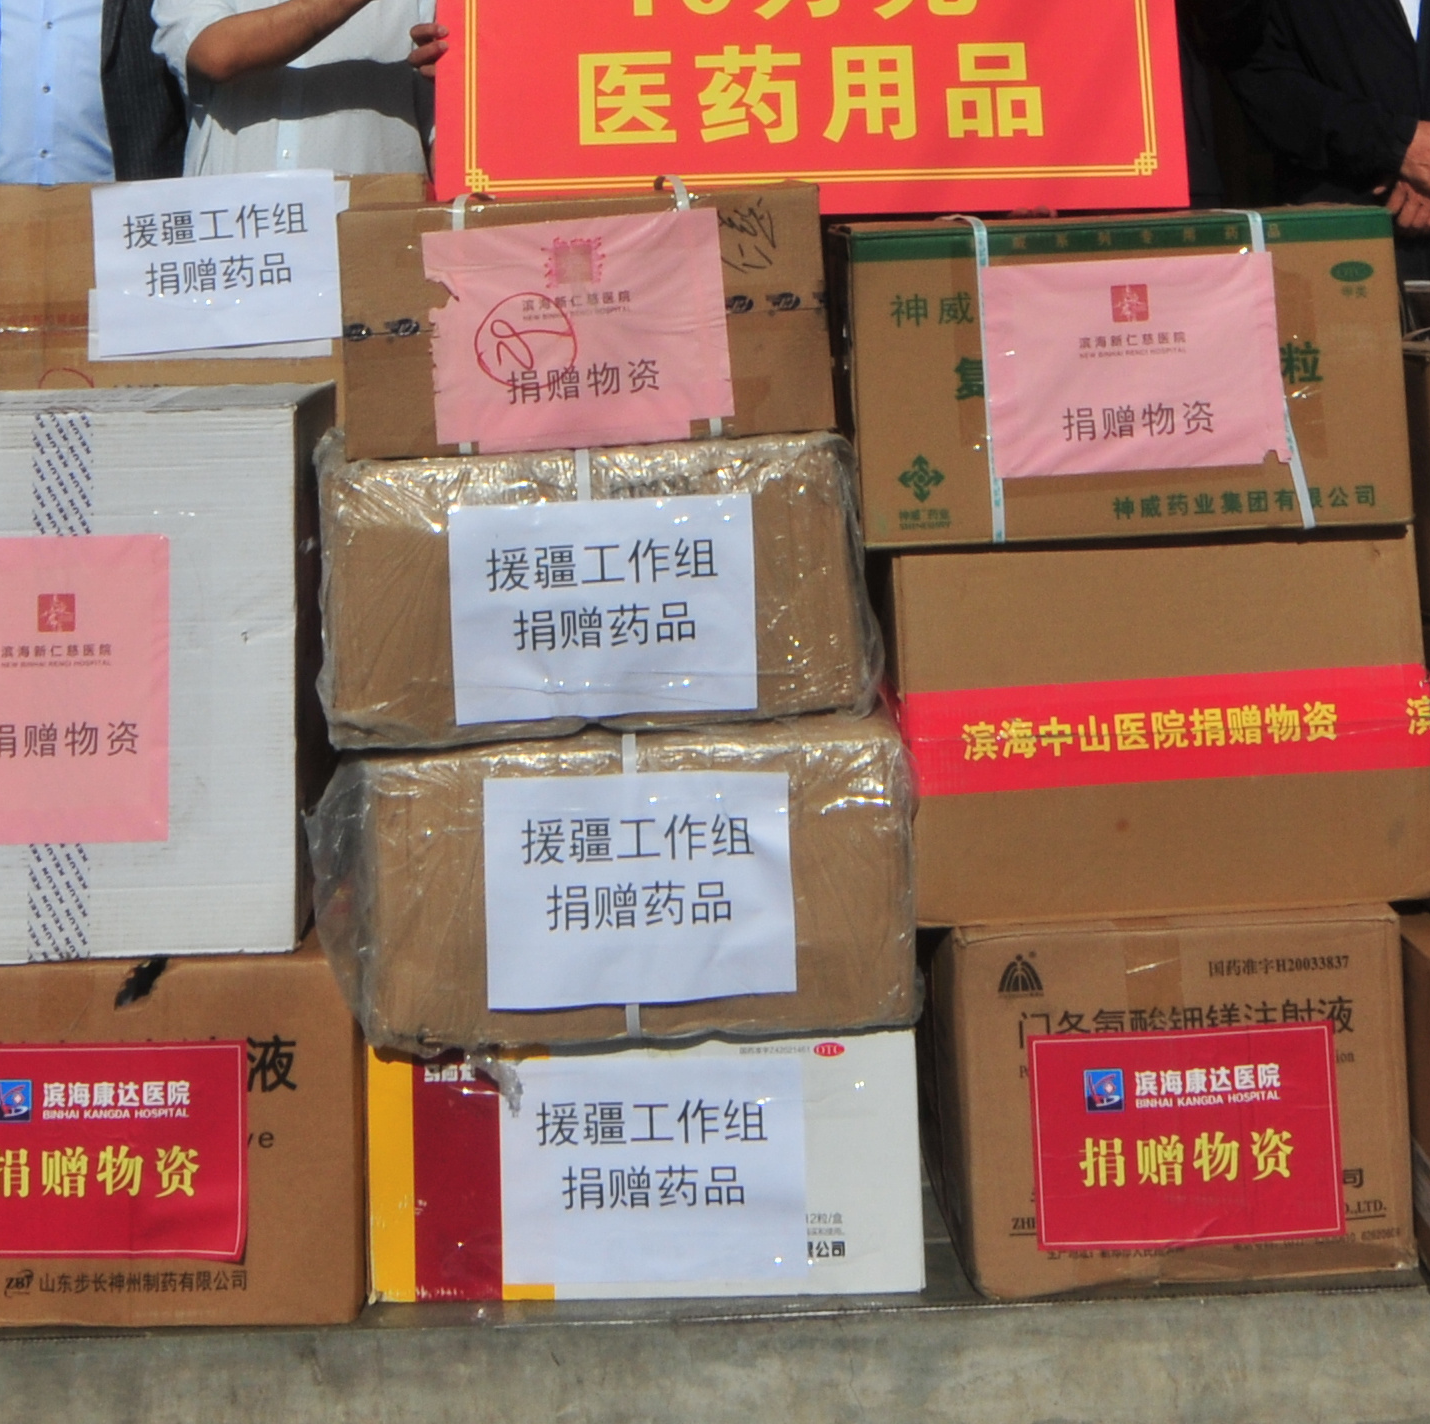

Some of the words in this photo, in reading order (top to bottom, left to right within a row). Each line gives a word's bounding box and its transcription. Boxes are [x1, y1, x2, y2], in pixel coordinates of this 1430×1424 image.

[577, 42, 1045, 147] 医药用品
[123, 202, 308, 250] 援疆工作组
[145, 252, 292, 297] 捐赠药品
[890, 290, 974, 328] 神威
[507, 359, 660, 406] 捐赠物资
[1063, 400, 1216, 443] 捐赠物资
[485, 536, 720, 592] 援疆工作组
[513, 601, 697, 653] 捐赠药品
[962, 700, 1338, 763] 滨海中山医院捐赠物资
[521, 813, 756, 865] 援疆工作组
[546, 880, 734, 932] 捐赠药品
[1208, 955, 1350, 978] 国药准字H20033837
[816, 1043, 842, 1057] OTC
[43, 1080, 191, 1107] 滨海康达医院
[1135, 1062, 1281, 1095] 滨海康达医院
[1135, 1096, 1174, 1109] BINHAI
[1177, 1094, 1223, 1107] KANGDA
[1227, 1090, 1280, 1104] HOSPITAL
[43, 1109, 79, 1119] BINHAI
[83, 1108, 131, 1119] KANGDA
[135, 1107, 189, 1119] HOSPITAL
[536, 1097, 769, 1148] 援疆工作组
[1079, 1128, 1294, 1188] 捐赠物资
[562, 1164, 747, 1211] 捐赠药品
[39, 1271, 248, 1295] 山东步长神州制药有限公司
